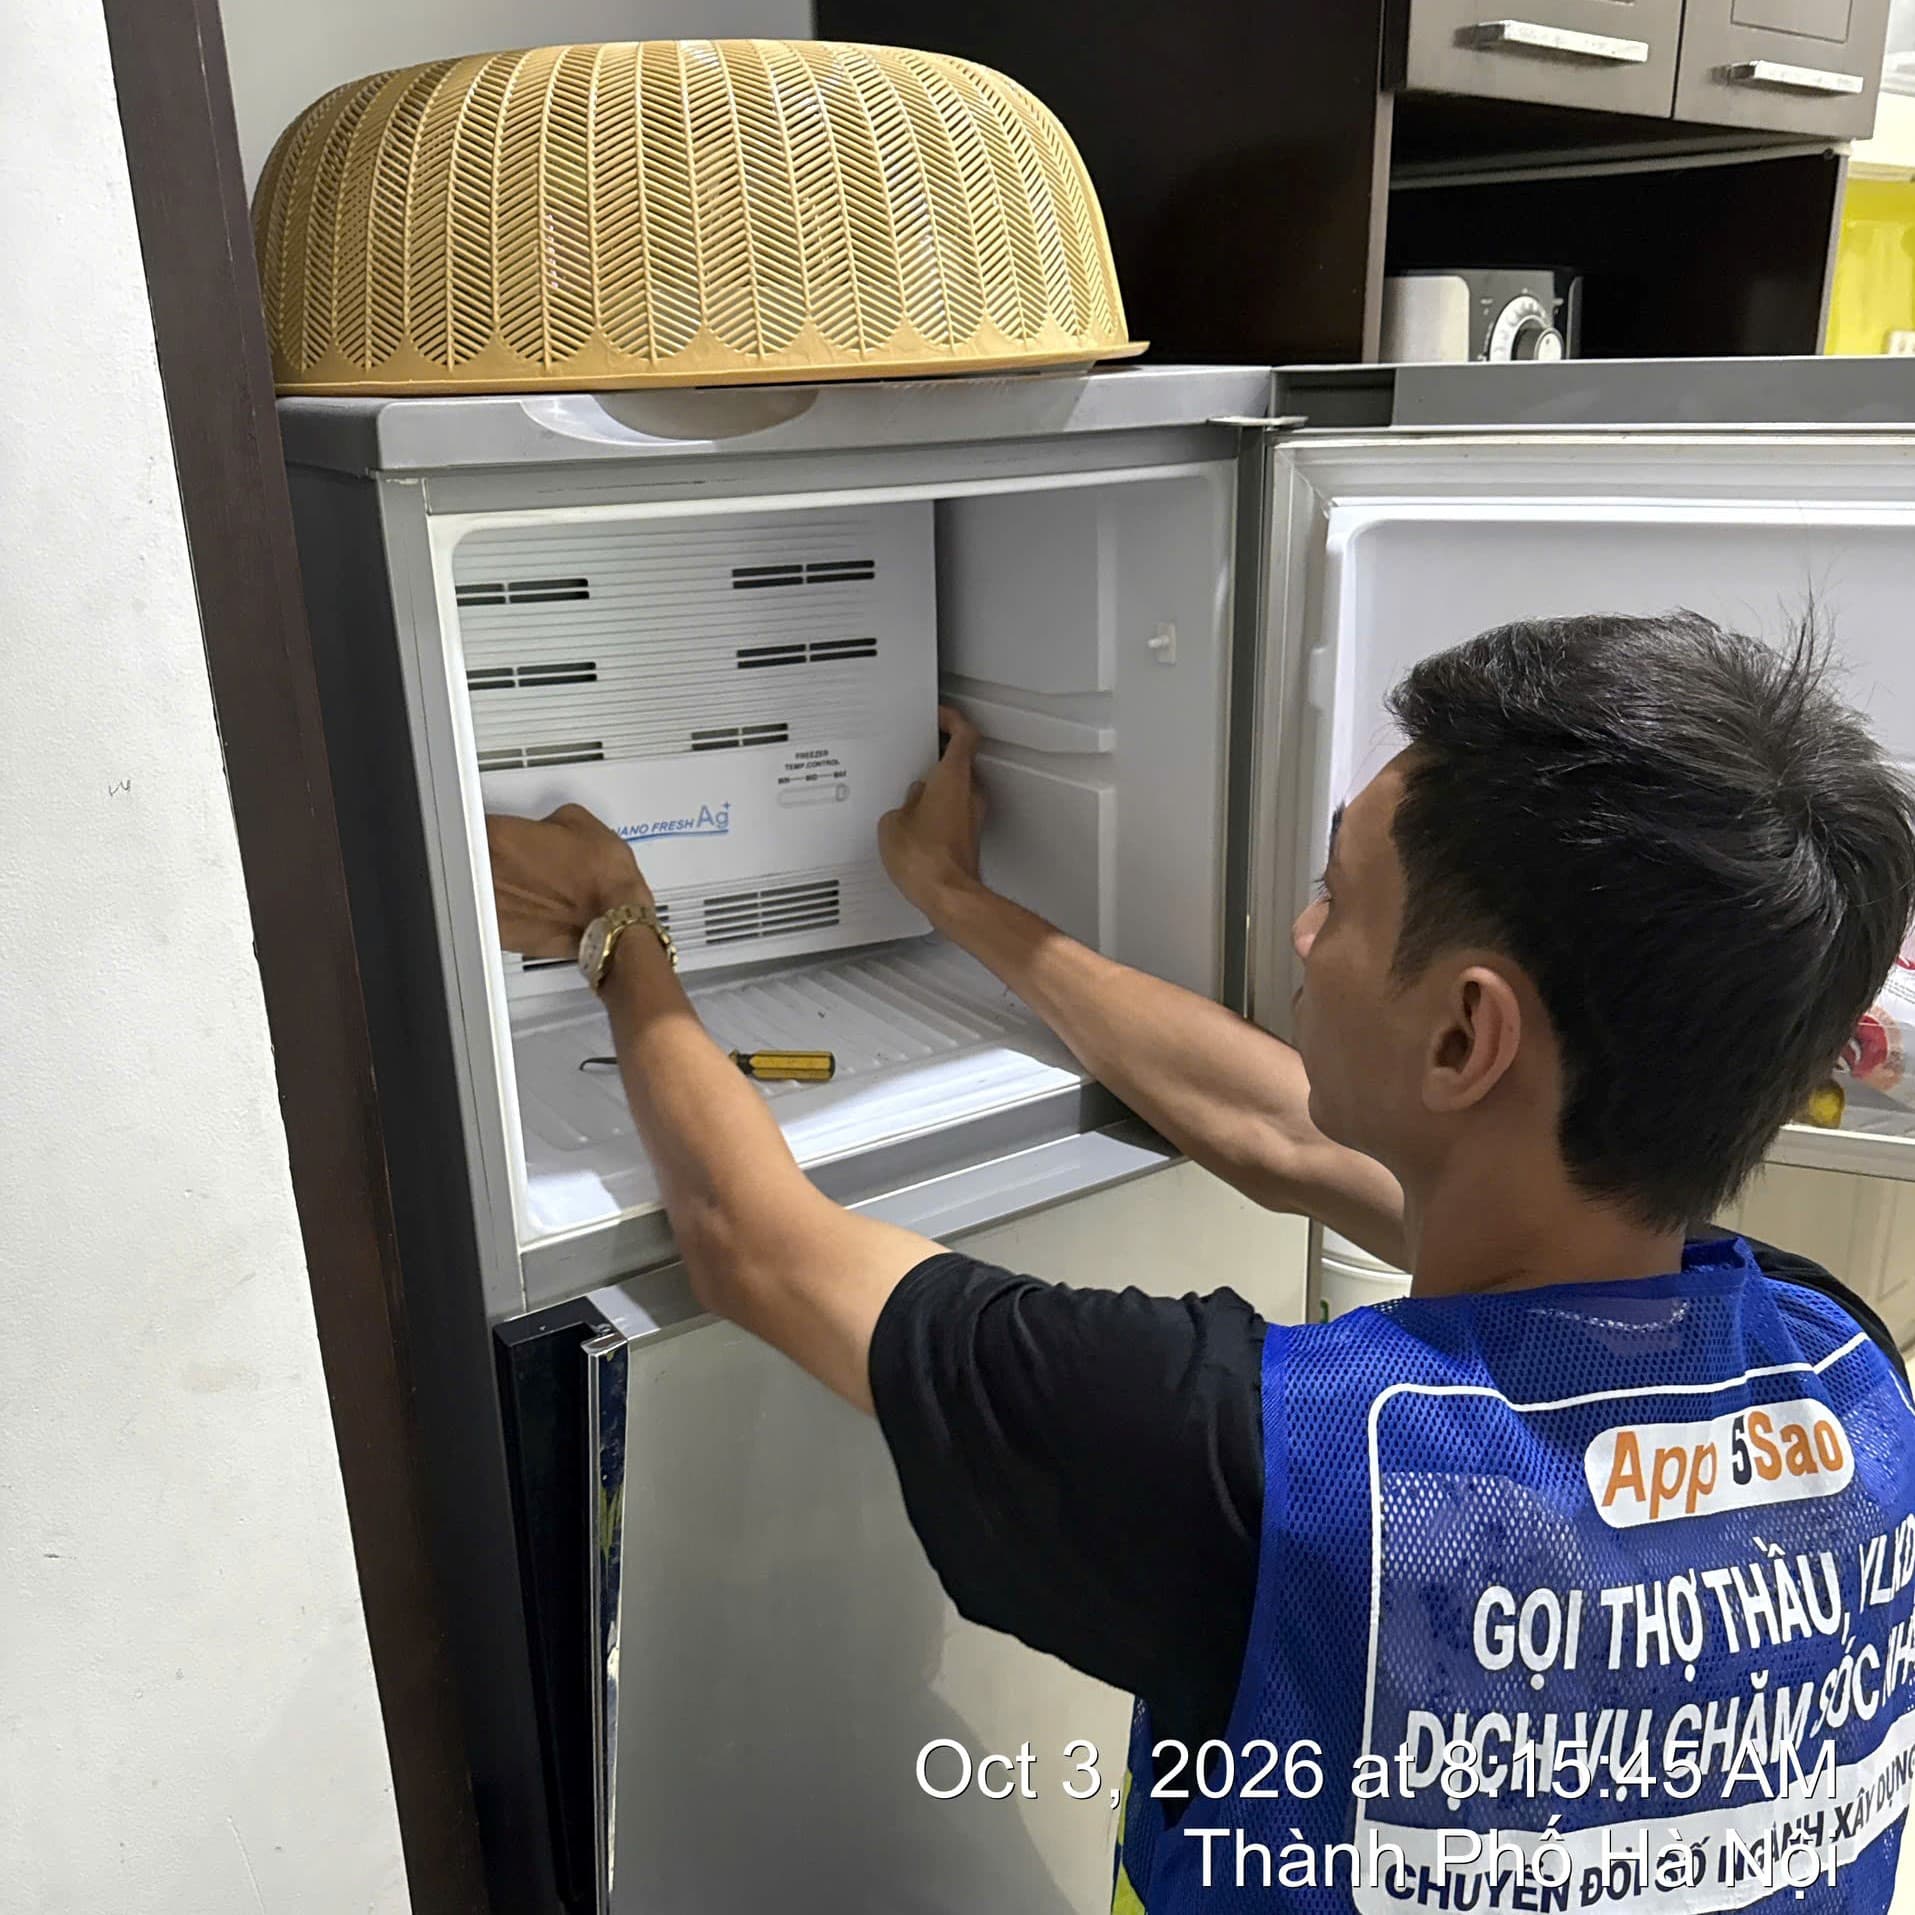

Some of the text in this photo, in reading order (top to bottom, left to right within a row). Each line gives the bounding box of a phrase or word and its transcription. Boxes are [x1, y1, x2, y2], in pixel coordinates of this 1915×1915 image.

[651, 817, 695, 834] FRESH
[1601, 1431, 1718, 1520] App
[1473, 1585, 1583, 1691] GỌI
[1600, 1567, 1704, 1683] THỢ
[1405, 1708, 1559, 1812] DỊCH
[1574, 1708, 1653, 1802] VỤ
[1663, 1669, 1815, 1778] CHĂM
